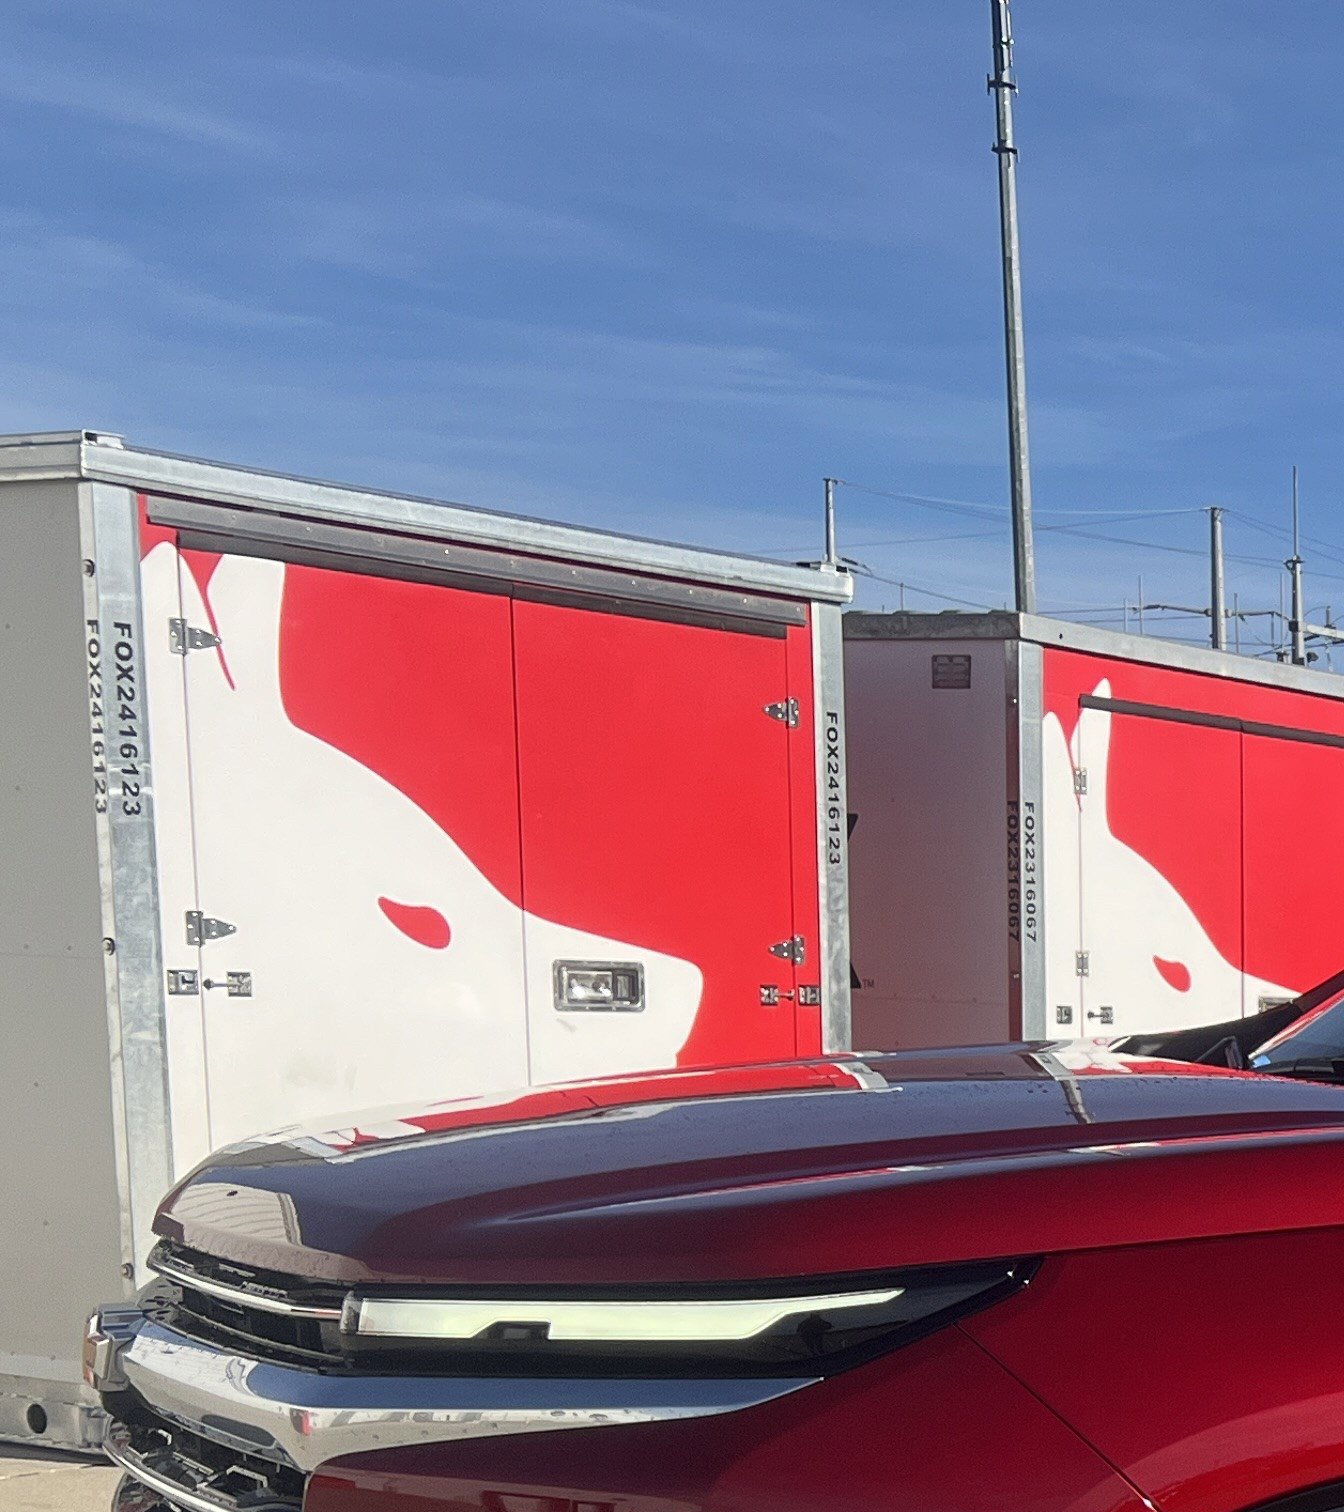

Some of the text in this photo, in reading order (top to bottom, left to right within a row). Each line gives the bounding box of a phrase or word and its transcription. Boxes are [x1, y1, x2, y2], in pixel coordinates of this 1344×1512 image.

[87, 619, 107, 815] FOX2416123
[113, 621, 141, 816] FOX2416123
[826, 711, 841, 865] FOX2416123
[1007, 801, 1020, 942] FOX2316067
[1025, 802, 1037, 942] FOX2316067
